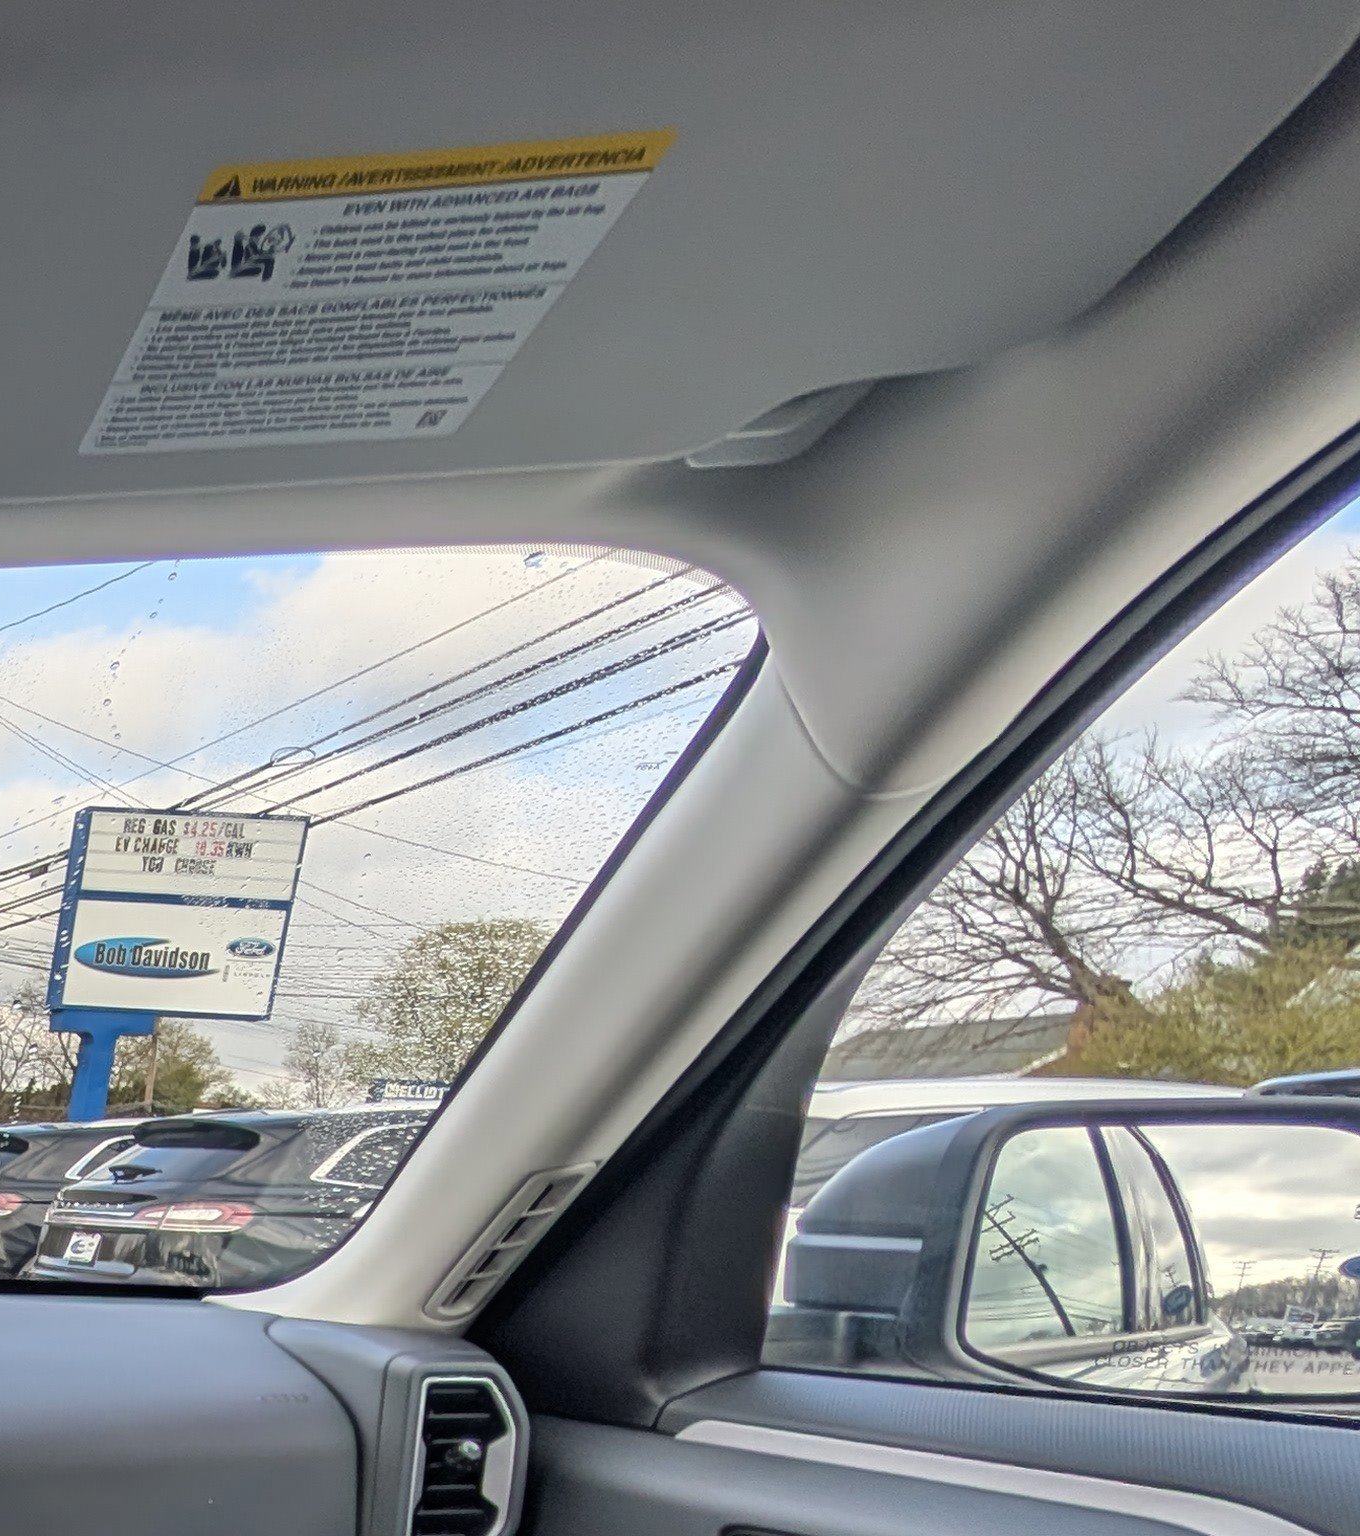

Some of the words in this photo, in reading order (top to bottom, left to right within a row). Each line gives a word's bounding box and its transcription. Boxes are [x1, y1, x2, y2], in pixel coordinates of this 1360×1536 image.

[249, 172, 339, 192] WARNING
[389, 197, 430, 211] WITH
[430, 190, 519, 208] ADVANCED
[519, 187, 549, 201] AIR
[153, 819, 177, 835] GAS
[115, 836, 130, 852] EV
[94, 943, 125, 966] Bob
[130, 943, 211, 970] Davidson
[1094, 1355, 1169, 1370] CLOSER
